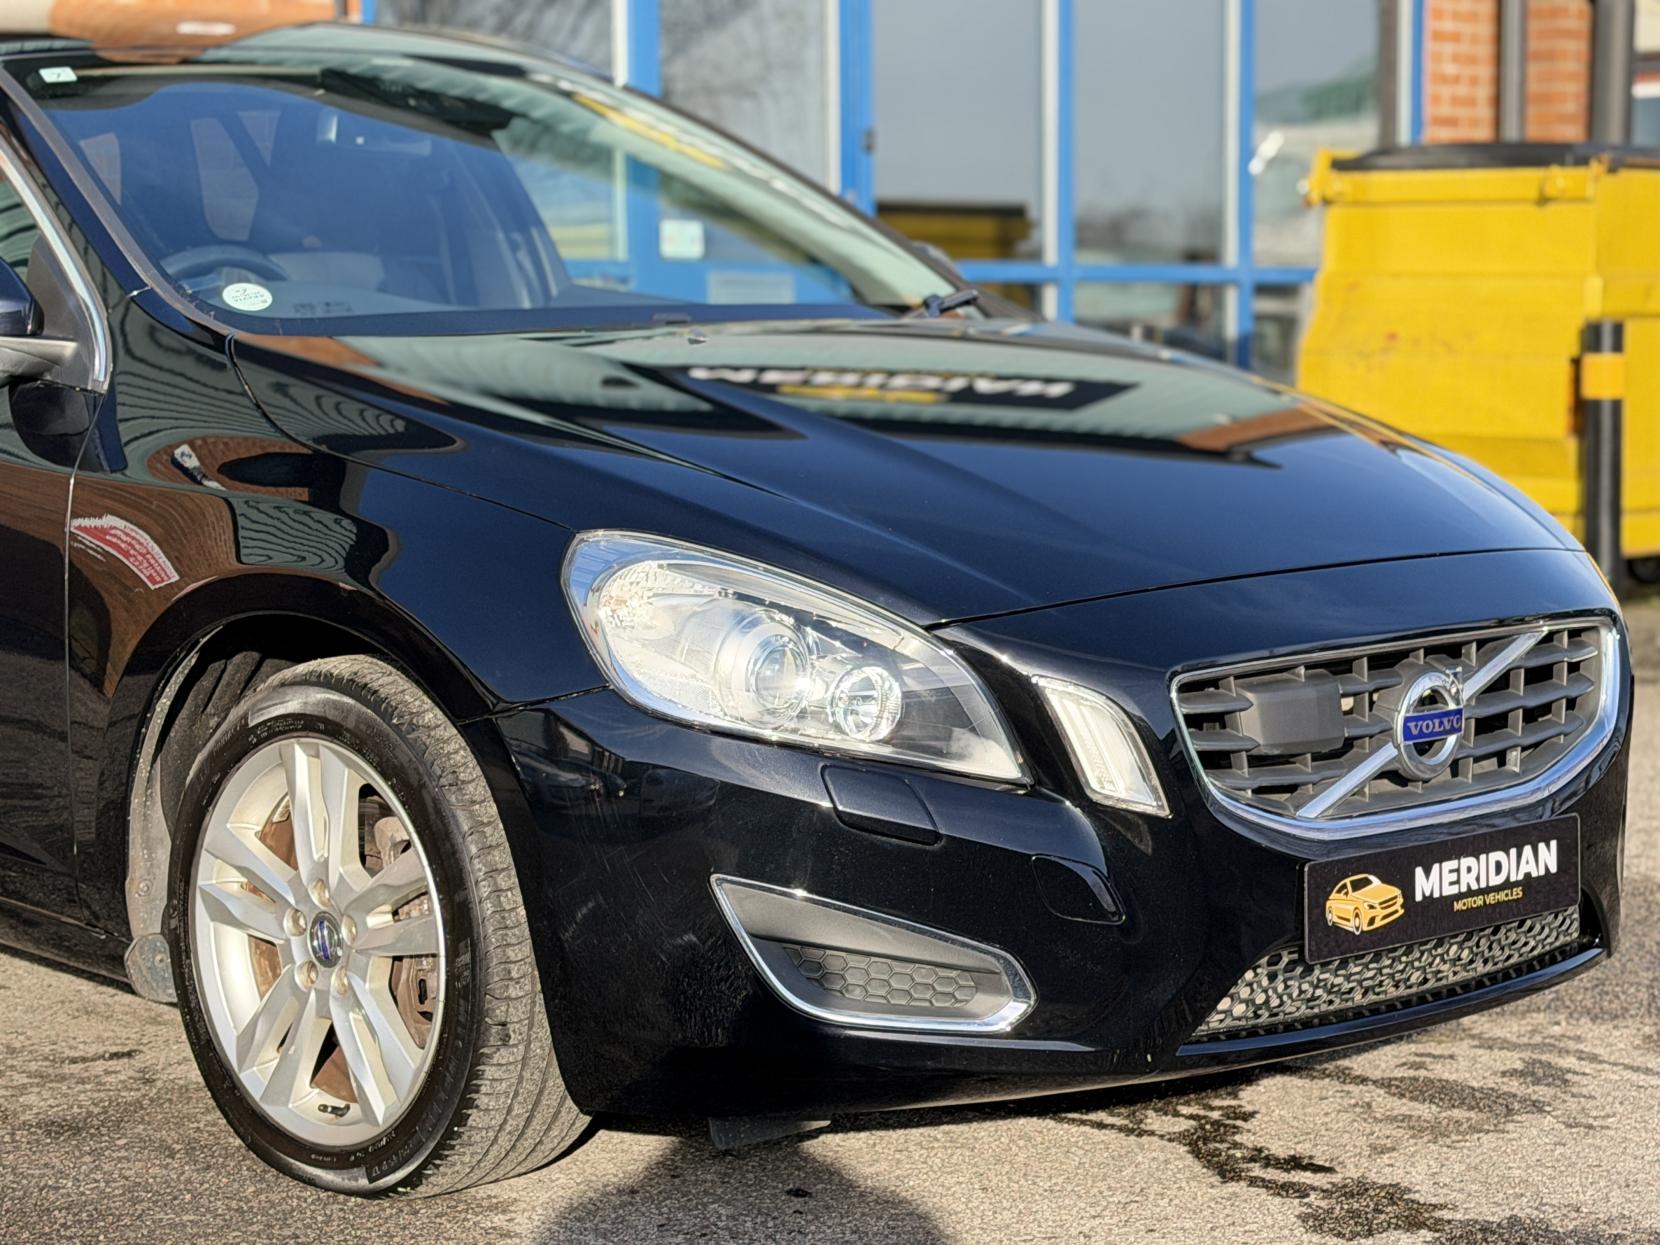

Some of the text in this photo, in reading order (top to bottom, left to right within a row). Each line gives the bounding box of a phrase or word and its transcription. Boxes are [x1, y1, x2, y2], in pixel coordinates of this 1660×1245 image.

[1414, 839, 1558, 902] MERIDIAN
[1453, 886, 1523, 912] MOTOR VEHICLES
